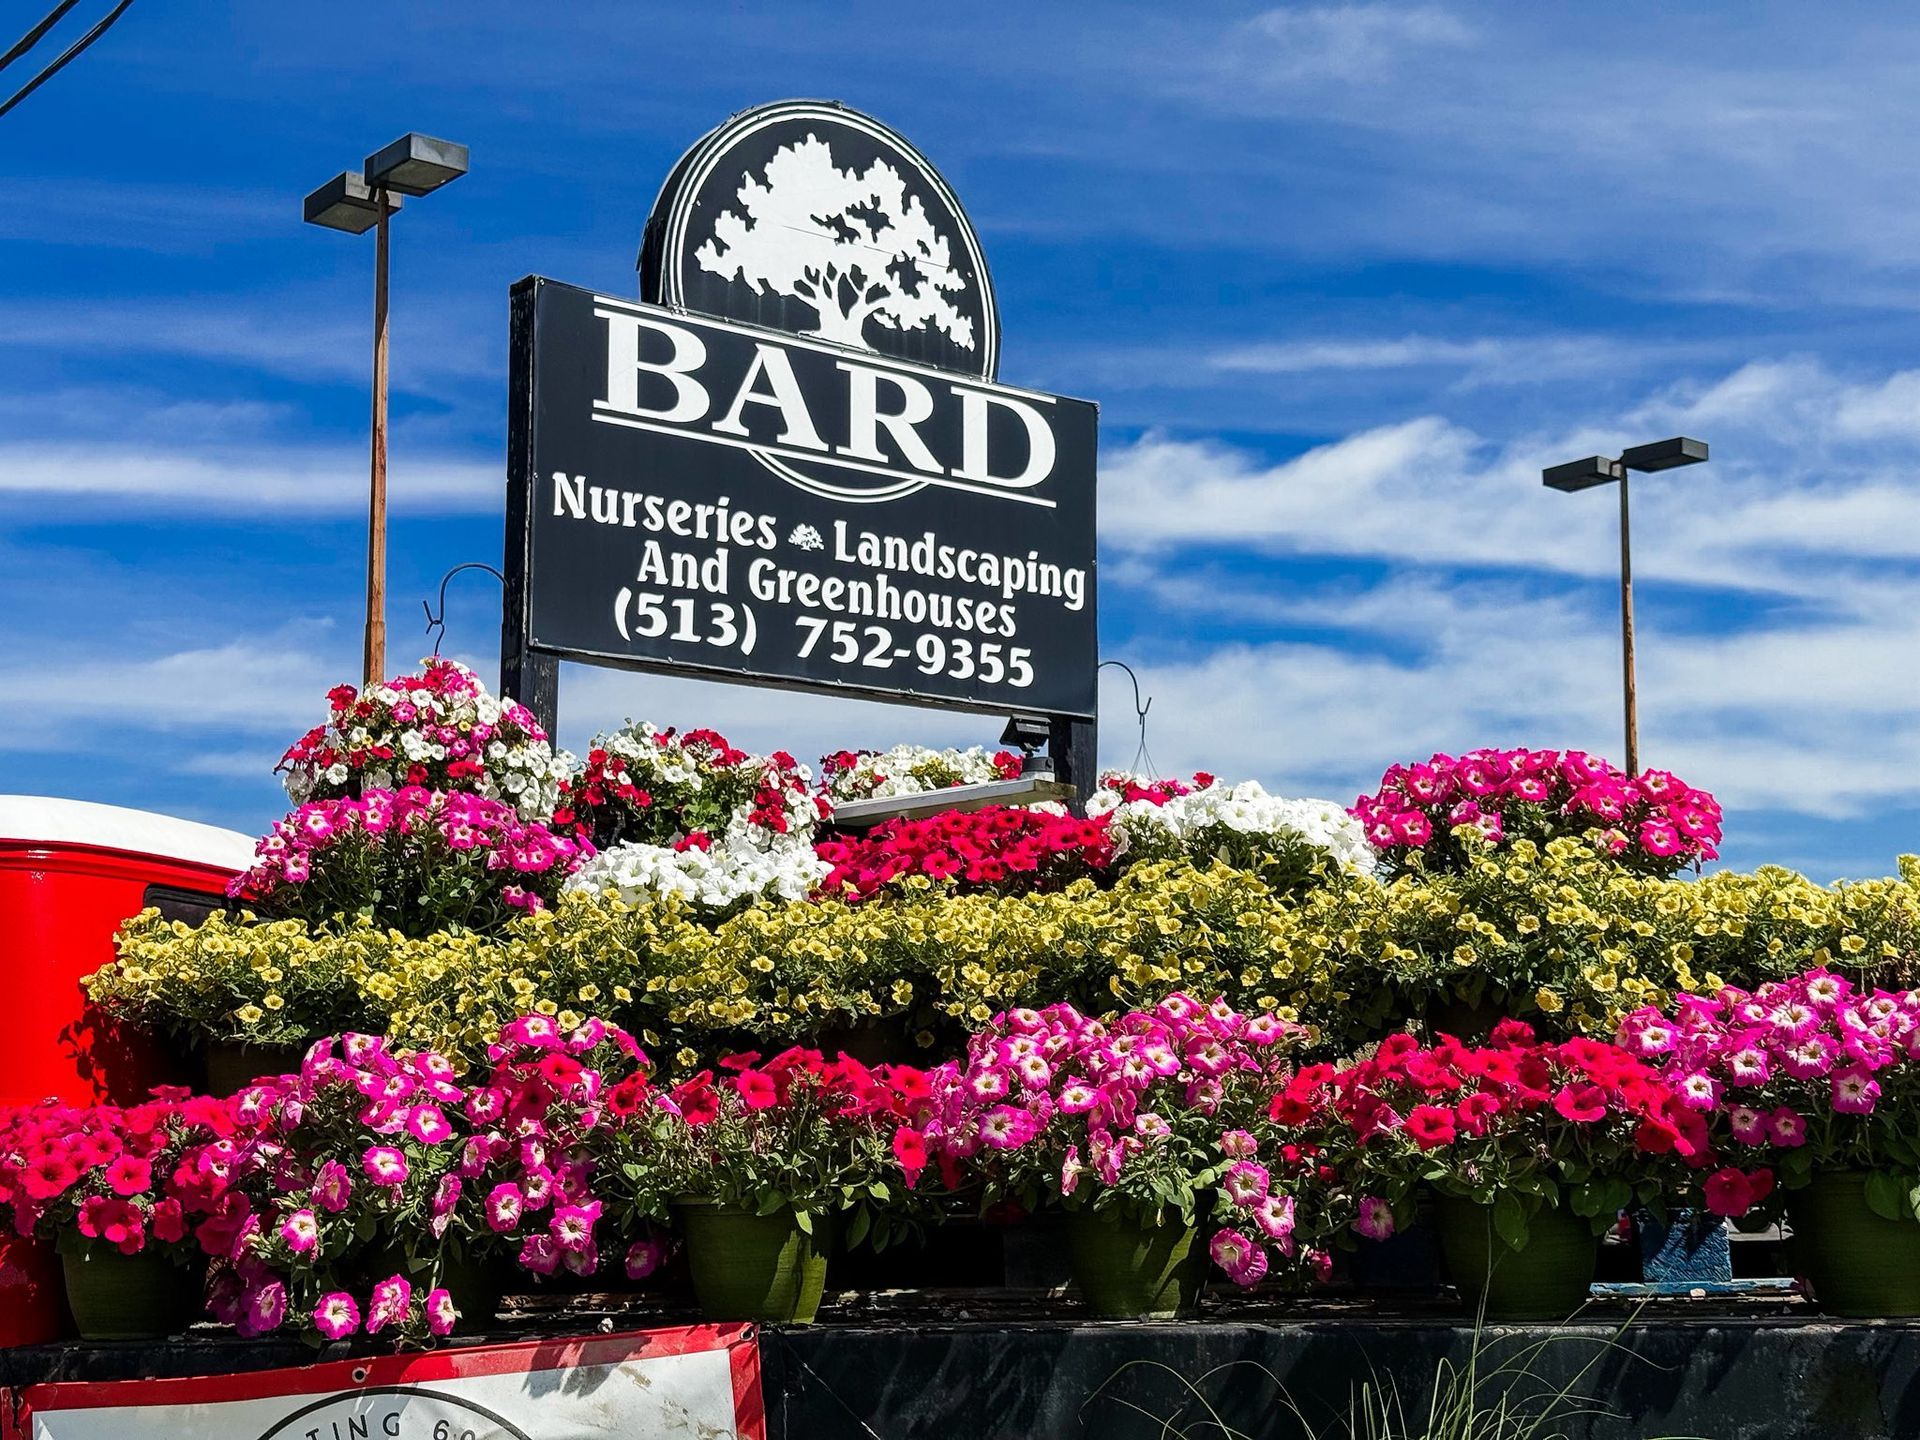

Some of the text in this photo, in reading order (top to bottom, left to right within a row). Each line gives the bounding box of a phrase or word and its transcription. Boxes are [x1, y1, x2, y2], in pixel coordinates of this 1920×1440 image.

[593, 308, 1057, 488] BARD
[553, 472, 1086, 611] Nurseries Landscaping
[637, 540, 1016, 639] And Greenhouses
[615, 587, 1034, 688] (513) 752-9355
